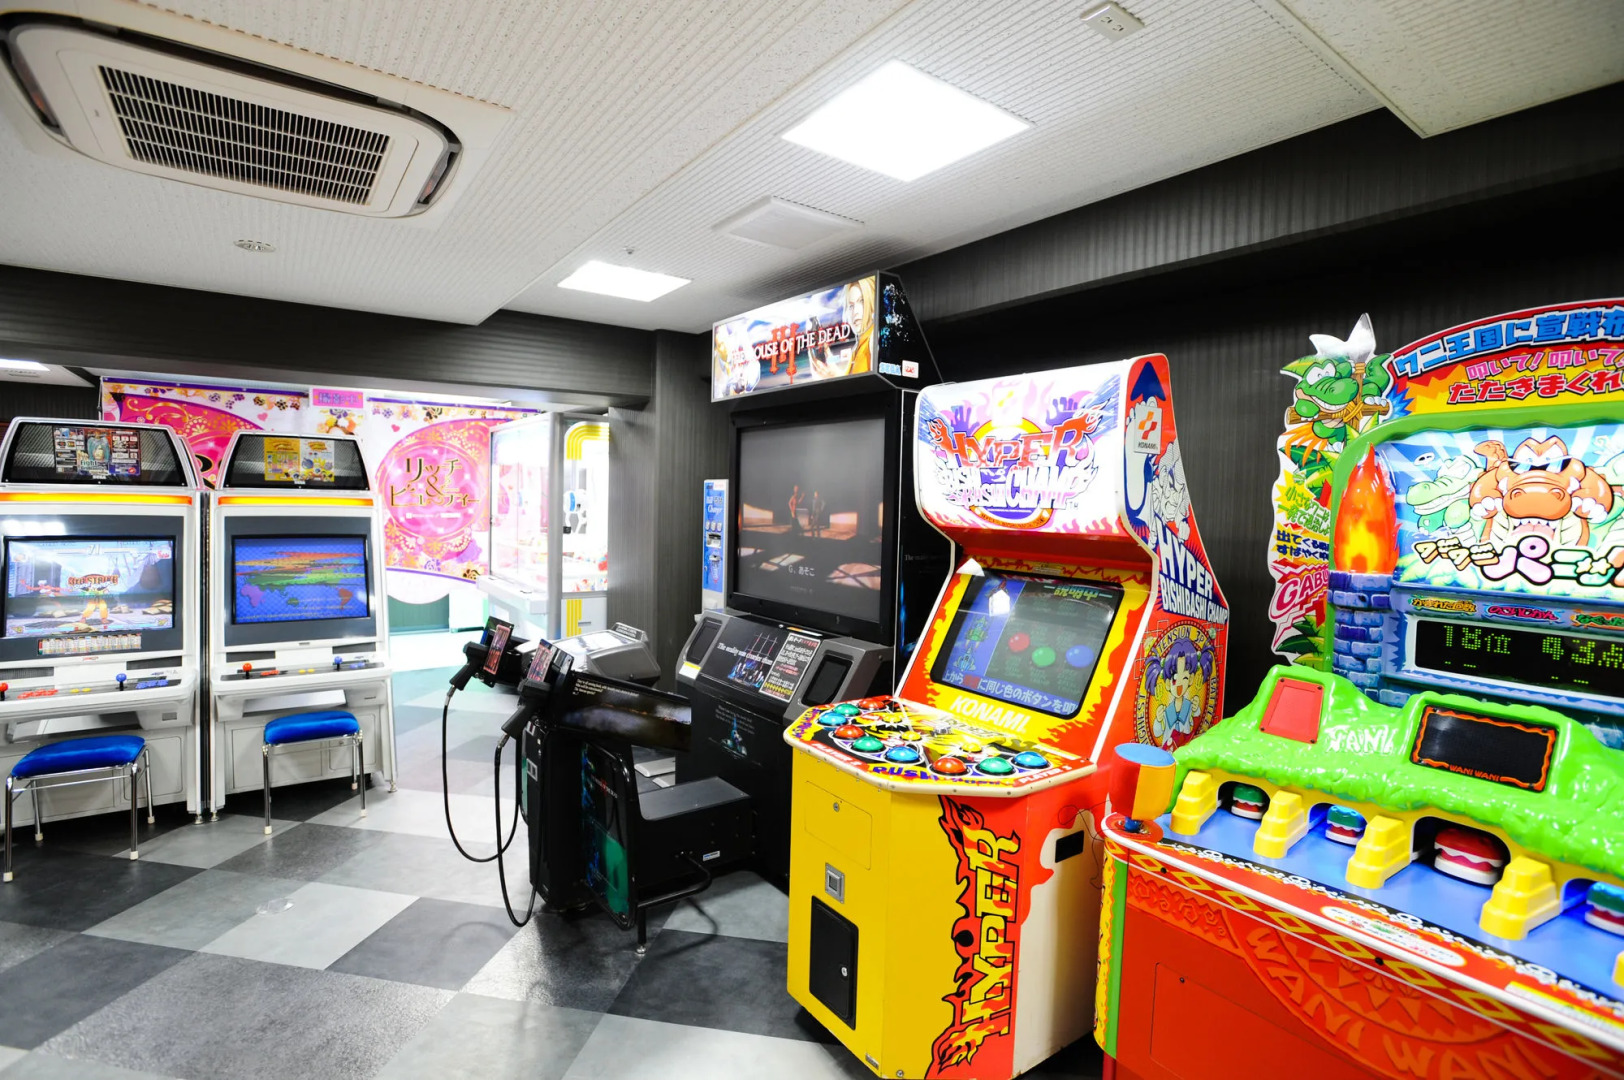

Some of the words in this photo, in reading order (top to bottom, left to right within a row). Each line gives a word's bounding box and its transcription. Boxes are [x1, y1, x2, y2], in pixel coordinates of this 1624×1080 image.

[780, 338, 794, 353] OF
[796, 331, 816, 354] THE
[818, 323, 851, 345] DEAD
[930, 400, 1101, 468] HYPER
[1137, 440, 1157, 450] KONAMI
[406, 458, 462, 483] リッチ
[1158, 520, 1213, 600] HYPER
[1206, 598, 1228, 625] CHAMP
[1158, 626, 1191, 654] TENSION
[1194, 630, 1206, 644] 3P
[950, 695, 1032, 732] KONAMI
[1017, 769, 1063, 784] PLAYER
[1448, 763, 1474, 776] WANI
[1474, 769, 1500, 783] WANI
[936, 815, 1021, 1068] HYPER
